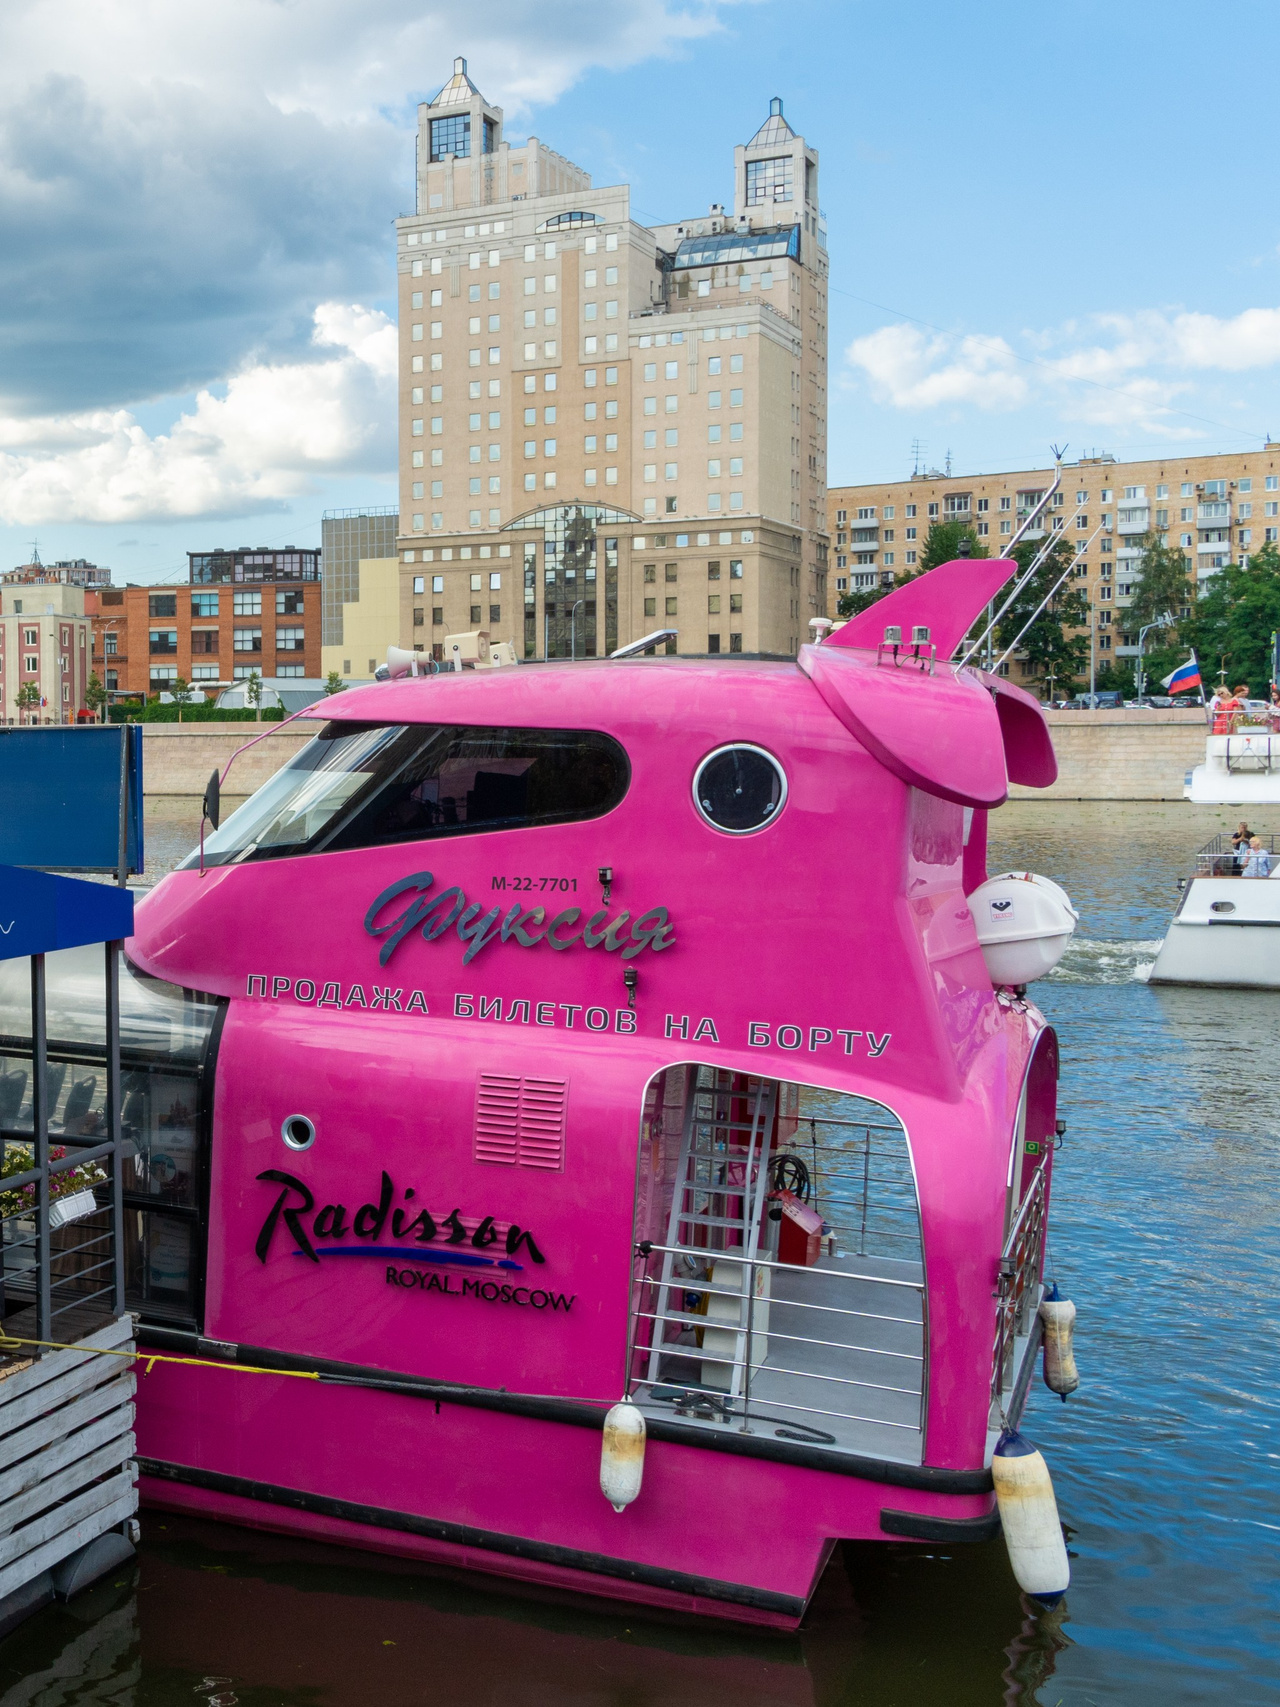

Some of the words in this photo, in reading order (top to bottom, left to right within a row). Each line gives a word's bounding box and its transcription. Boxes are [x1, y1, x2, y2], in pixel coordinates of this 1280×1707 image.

[363, 871, 676, 968] Фуксия
[246, 973, 429, 1014] ПРОДАЖА
[453, 993, 638, 1034] БИЛЕТОВ
[664, 1014, 720, 1042] НА
[747, 1021, 892, 1057] БОРТУ
[255, 1169, 546, 1264] Radisson
[461, 1277, 577, 1313] MOSCOW
